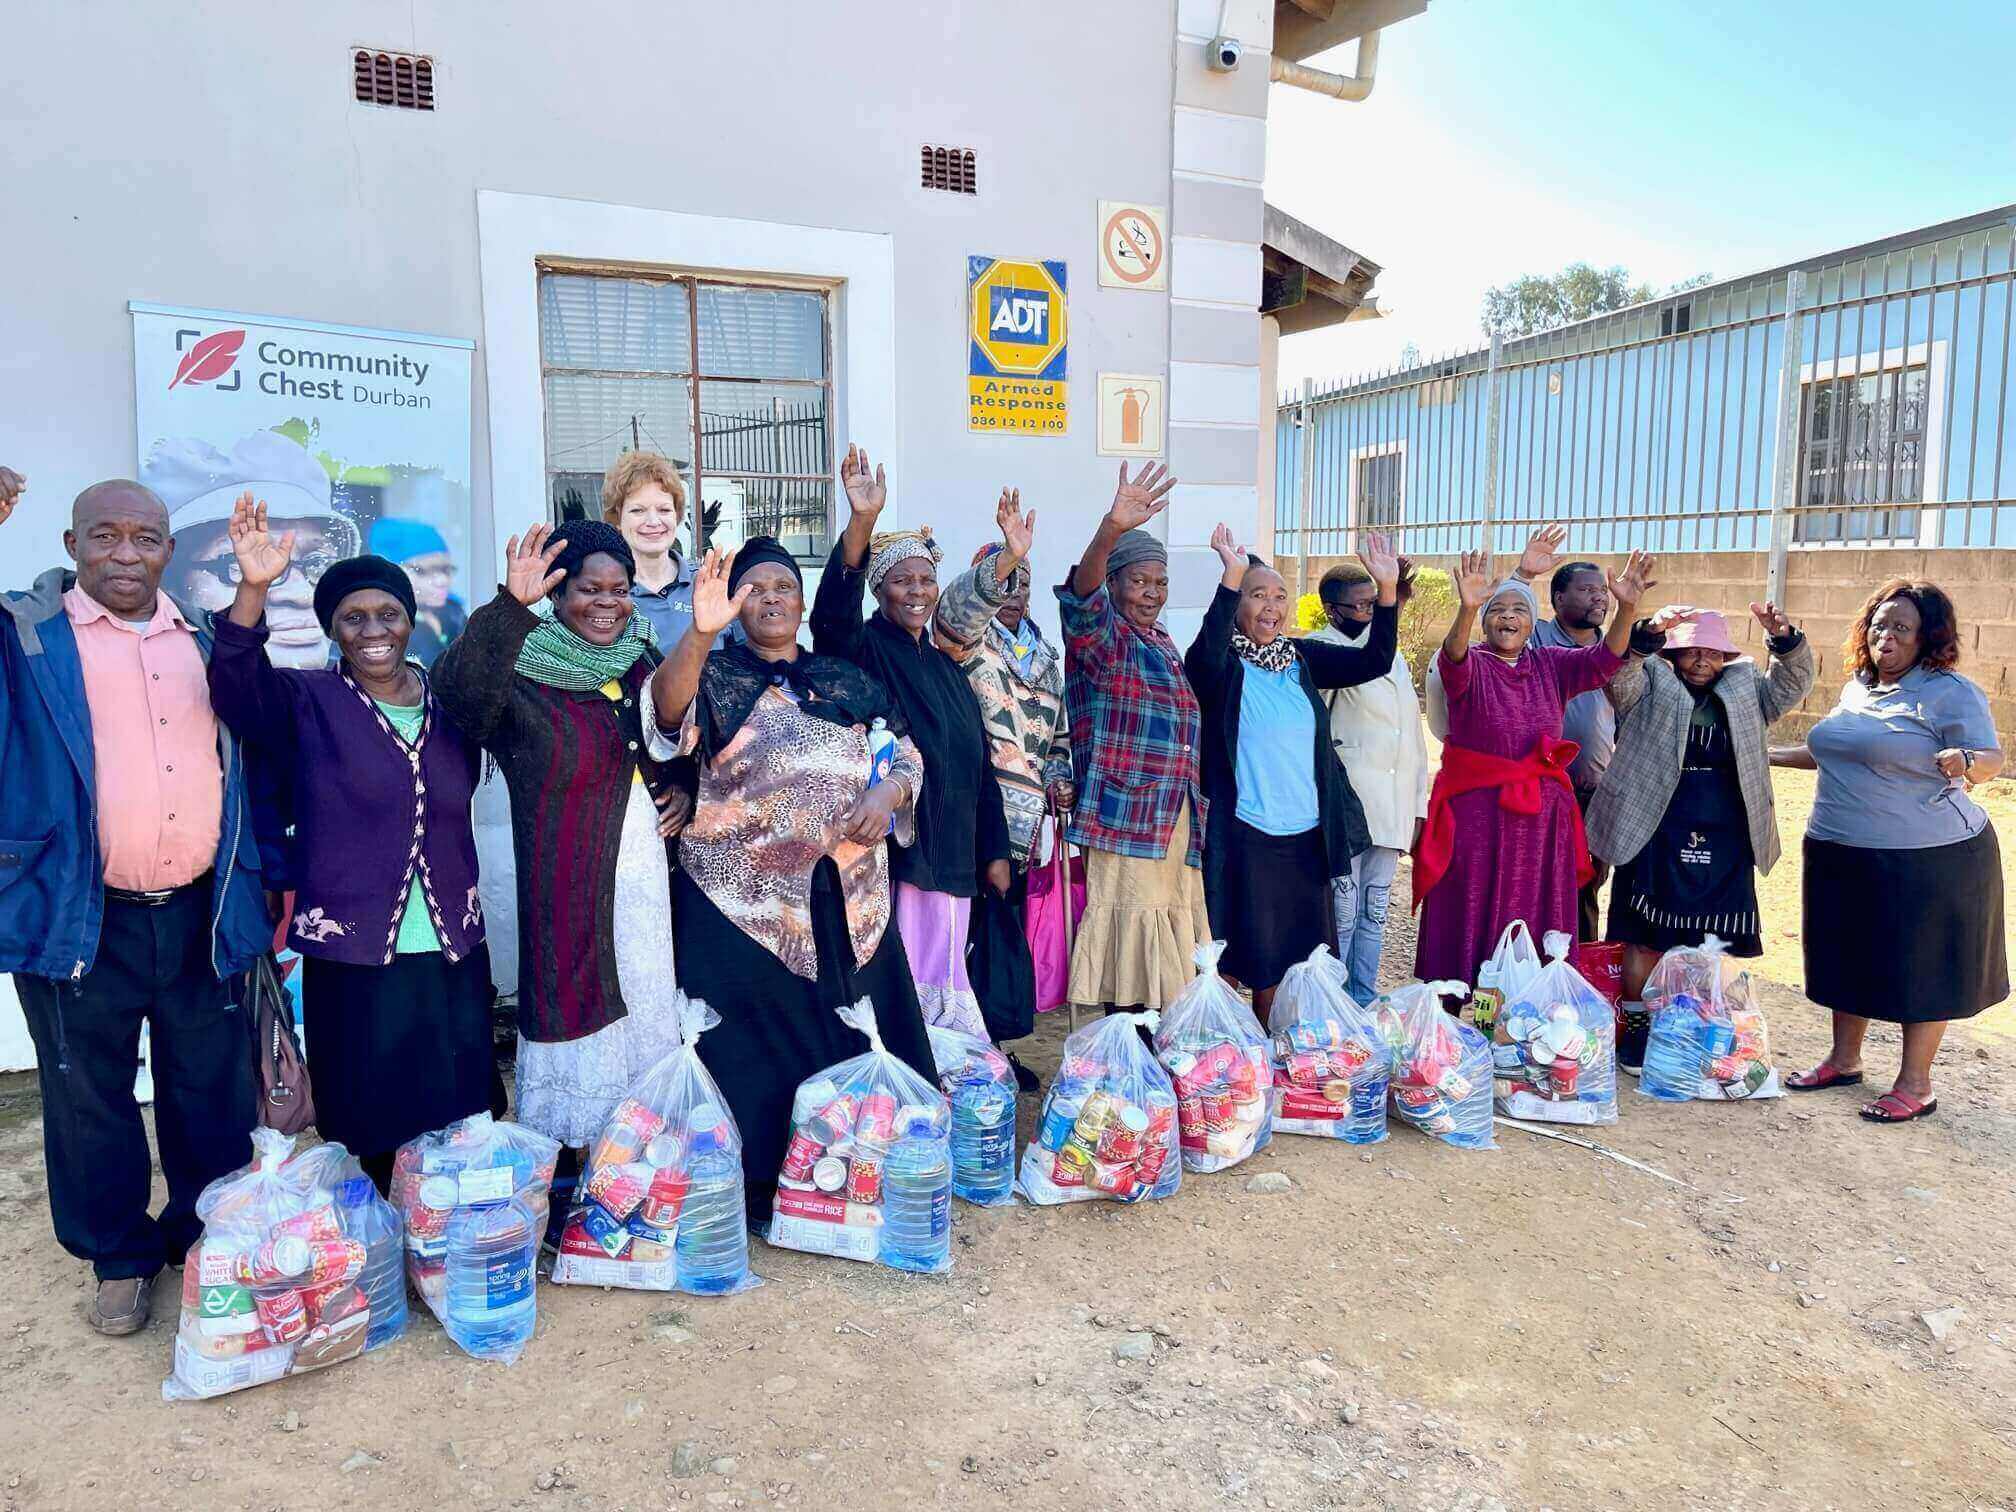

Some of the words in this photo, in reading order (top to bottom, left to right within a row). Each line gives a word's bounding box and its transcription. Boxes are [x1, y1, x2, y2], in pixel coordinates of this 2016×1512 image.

[990, 298, 1048, 336] ADT
[258, 341, 430, 386] Community
[258, 371, 344, 401] Chest
[353, 385, 432, 409] Durban
[984, 381, 1054, 396] Armed
[970, 395, 1066, 411] Response
[971, 416, 996, 427] 086
[1002, 417, 1016, 427] 12
[1022, 418, 1037, 428] 12
[1042, 419, 1064, 430] 100
[824, 1204, 844, 1216] RICE
